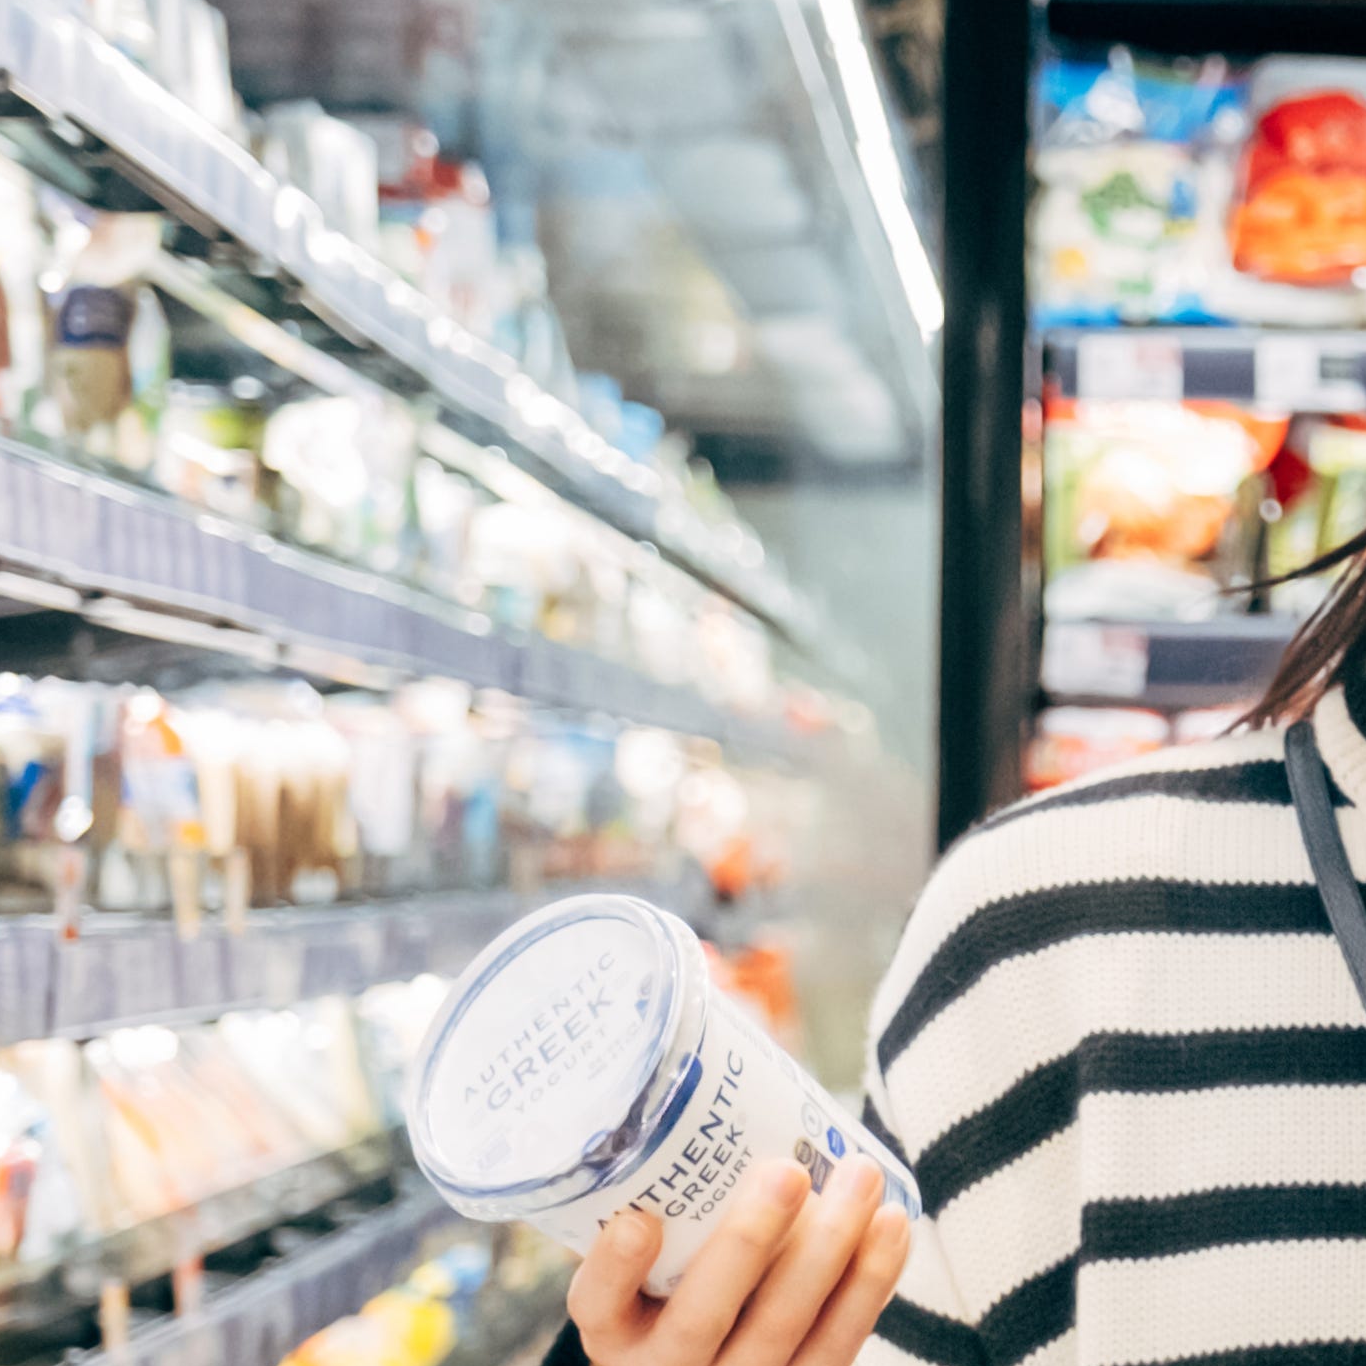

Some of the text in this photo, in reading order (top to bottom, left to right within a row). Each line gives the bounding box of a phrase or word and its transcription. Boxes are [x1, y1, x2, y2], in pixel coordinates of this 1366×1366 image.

[463, 951, 616, 1105] AUTHENTIC
[486, 986, 614, 1111] GREEK
[597, 1050, 744, 1232] THENTIC
[664, 1124, 745, 1218] GREEK
[689, 1146, 754, 1223] YOGURT
